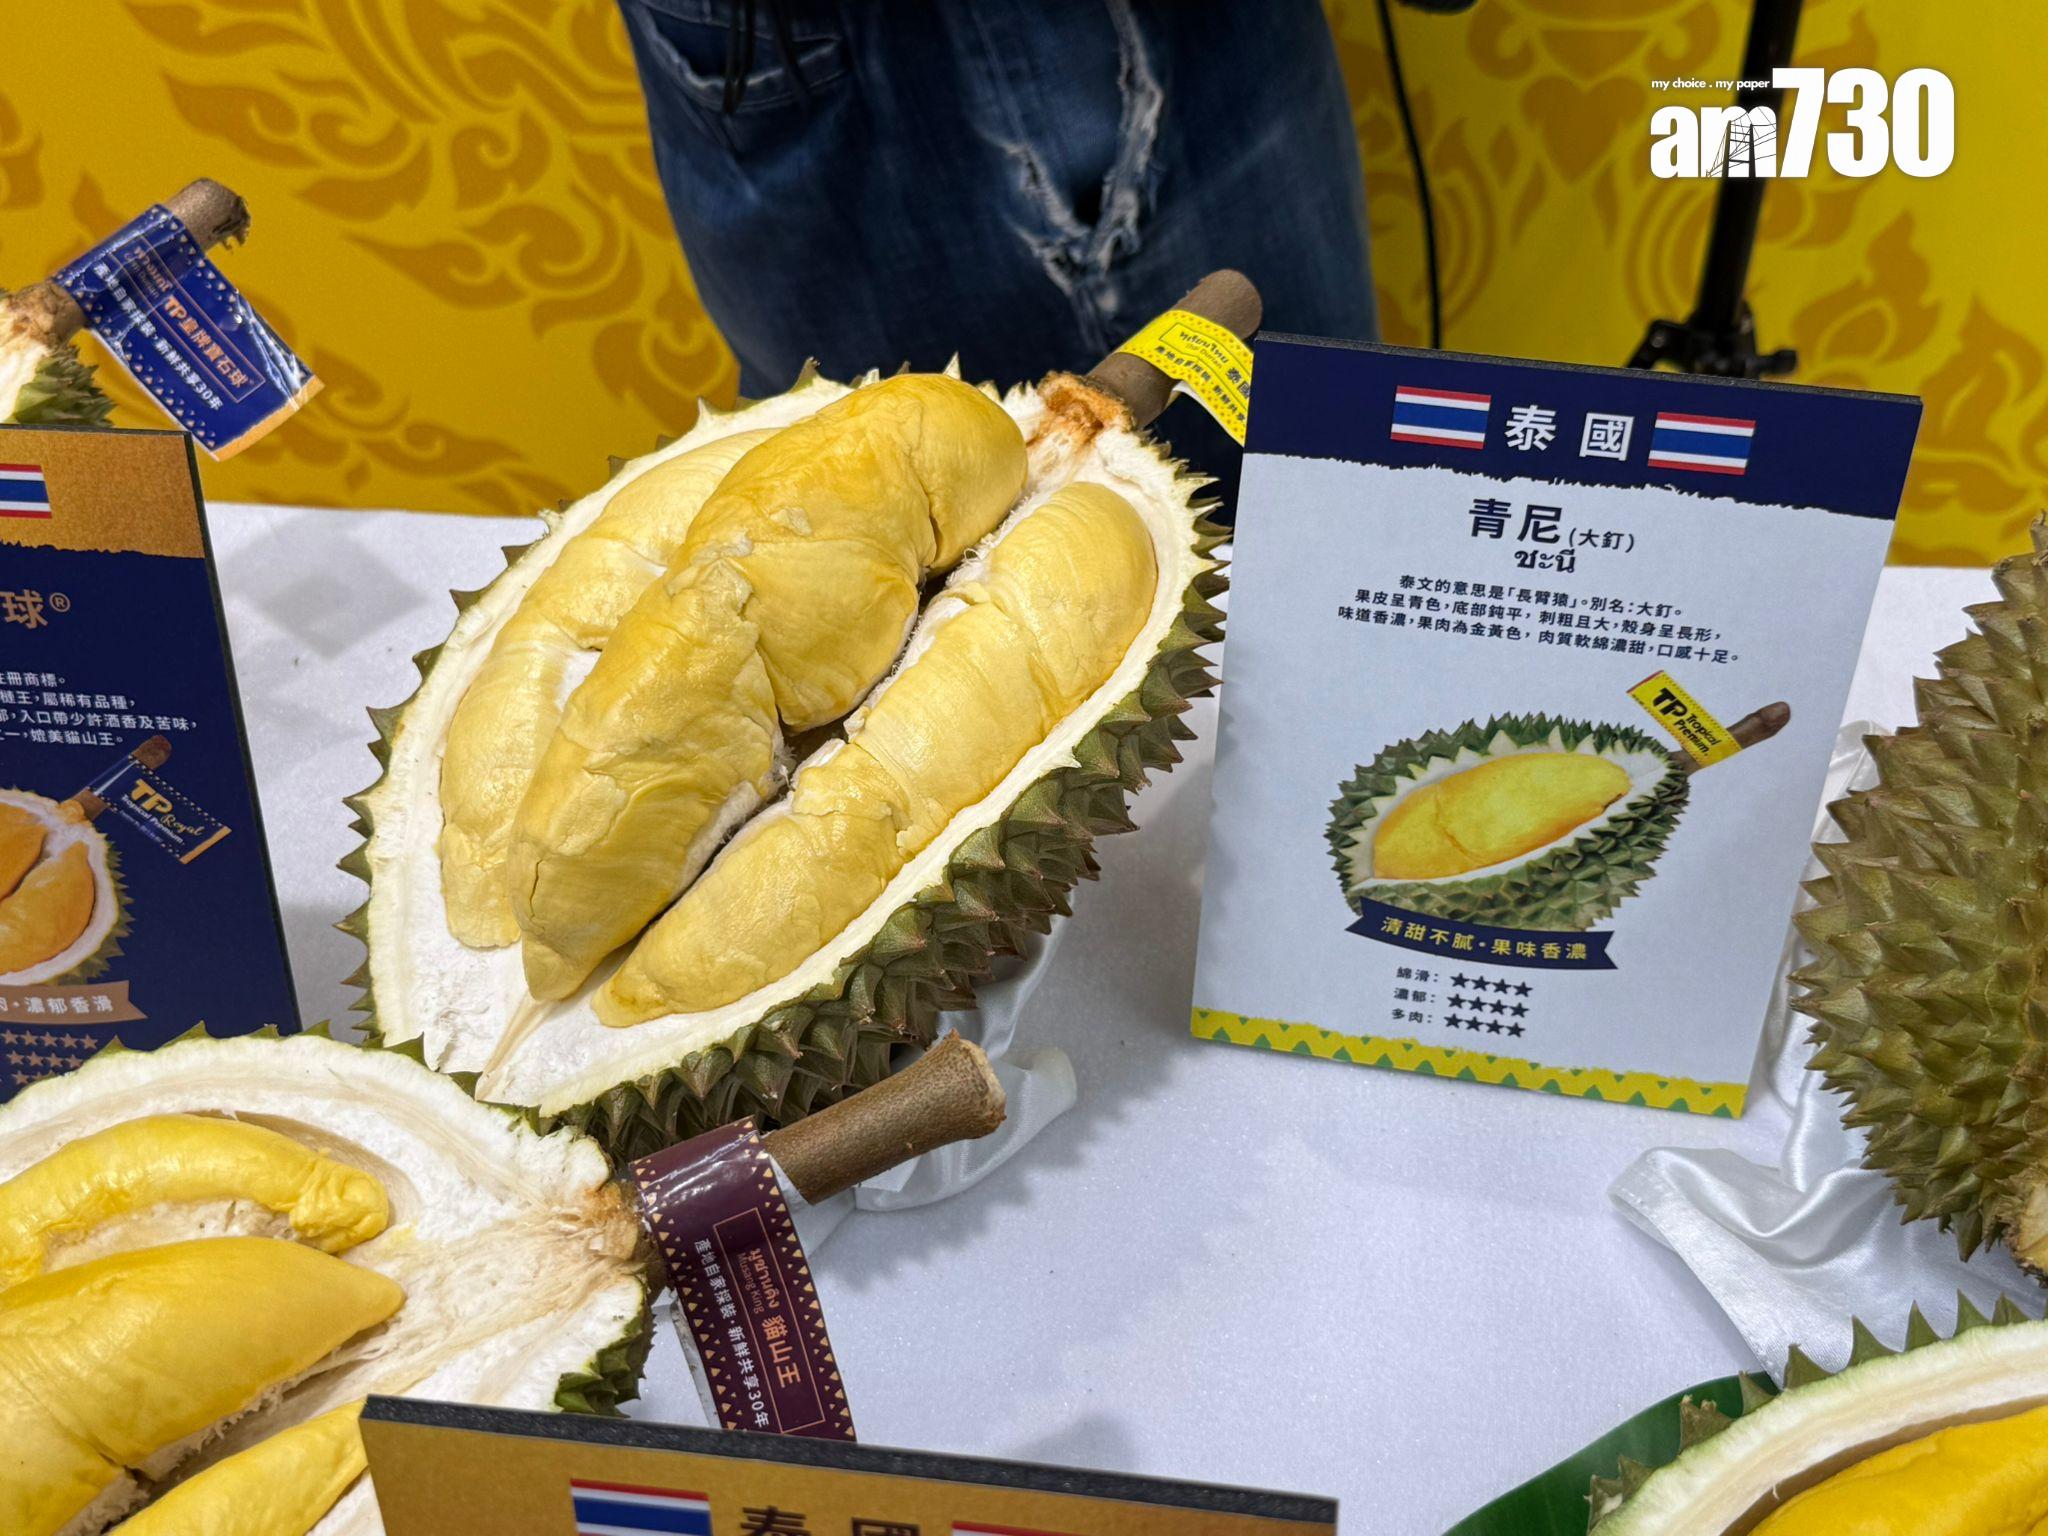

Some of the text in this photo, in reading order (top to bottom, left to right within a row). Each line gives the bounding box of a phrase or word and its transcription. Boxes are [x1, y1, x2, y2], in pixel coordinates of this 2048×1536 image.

[1514, 548, 1576, 573] ชะนี
[1653, 687, 1688, 718] TP
[1686, 712, 1722, 746] Tropical
[120, 793, 153, 820] Tropical
[131, 778, 173, 814] TP
[160, 813, 206, 836] Royal
[737, 1251, 765, 1315] Musang King
[761, 1315, 802, 1389] 貓山王
